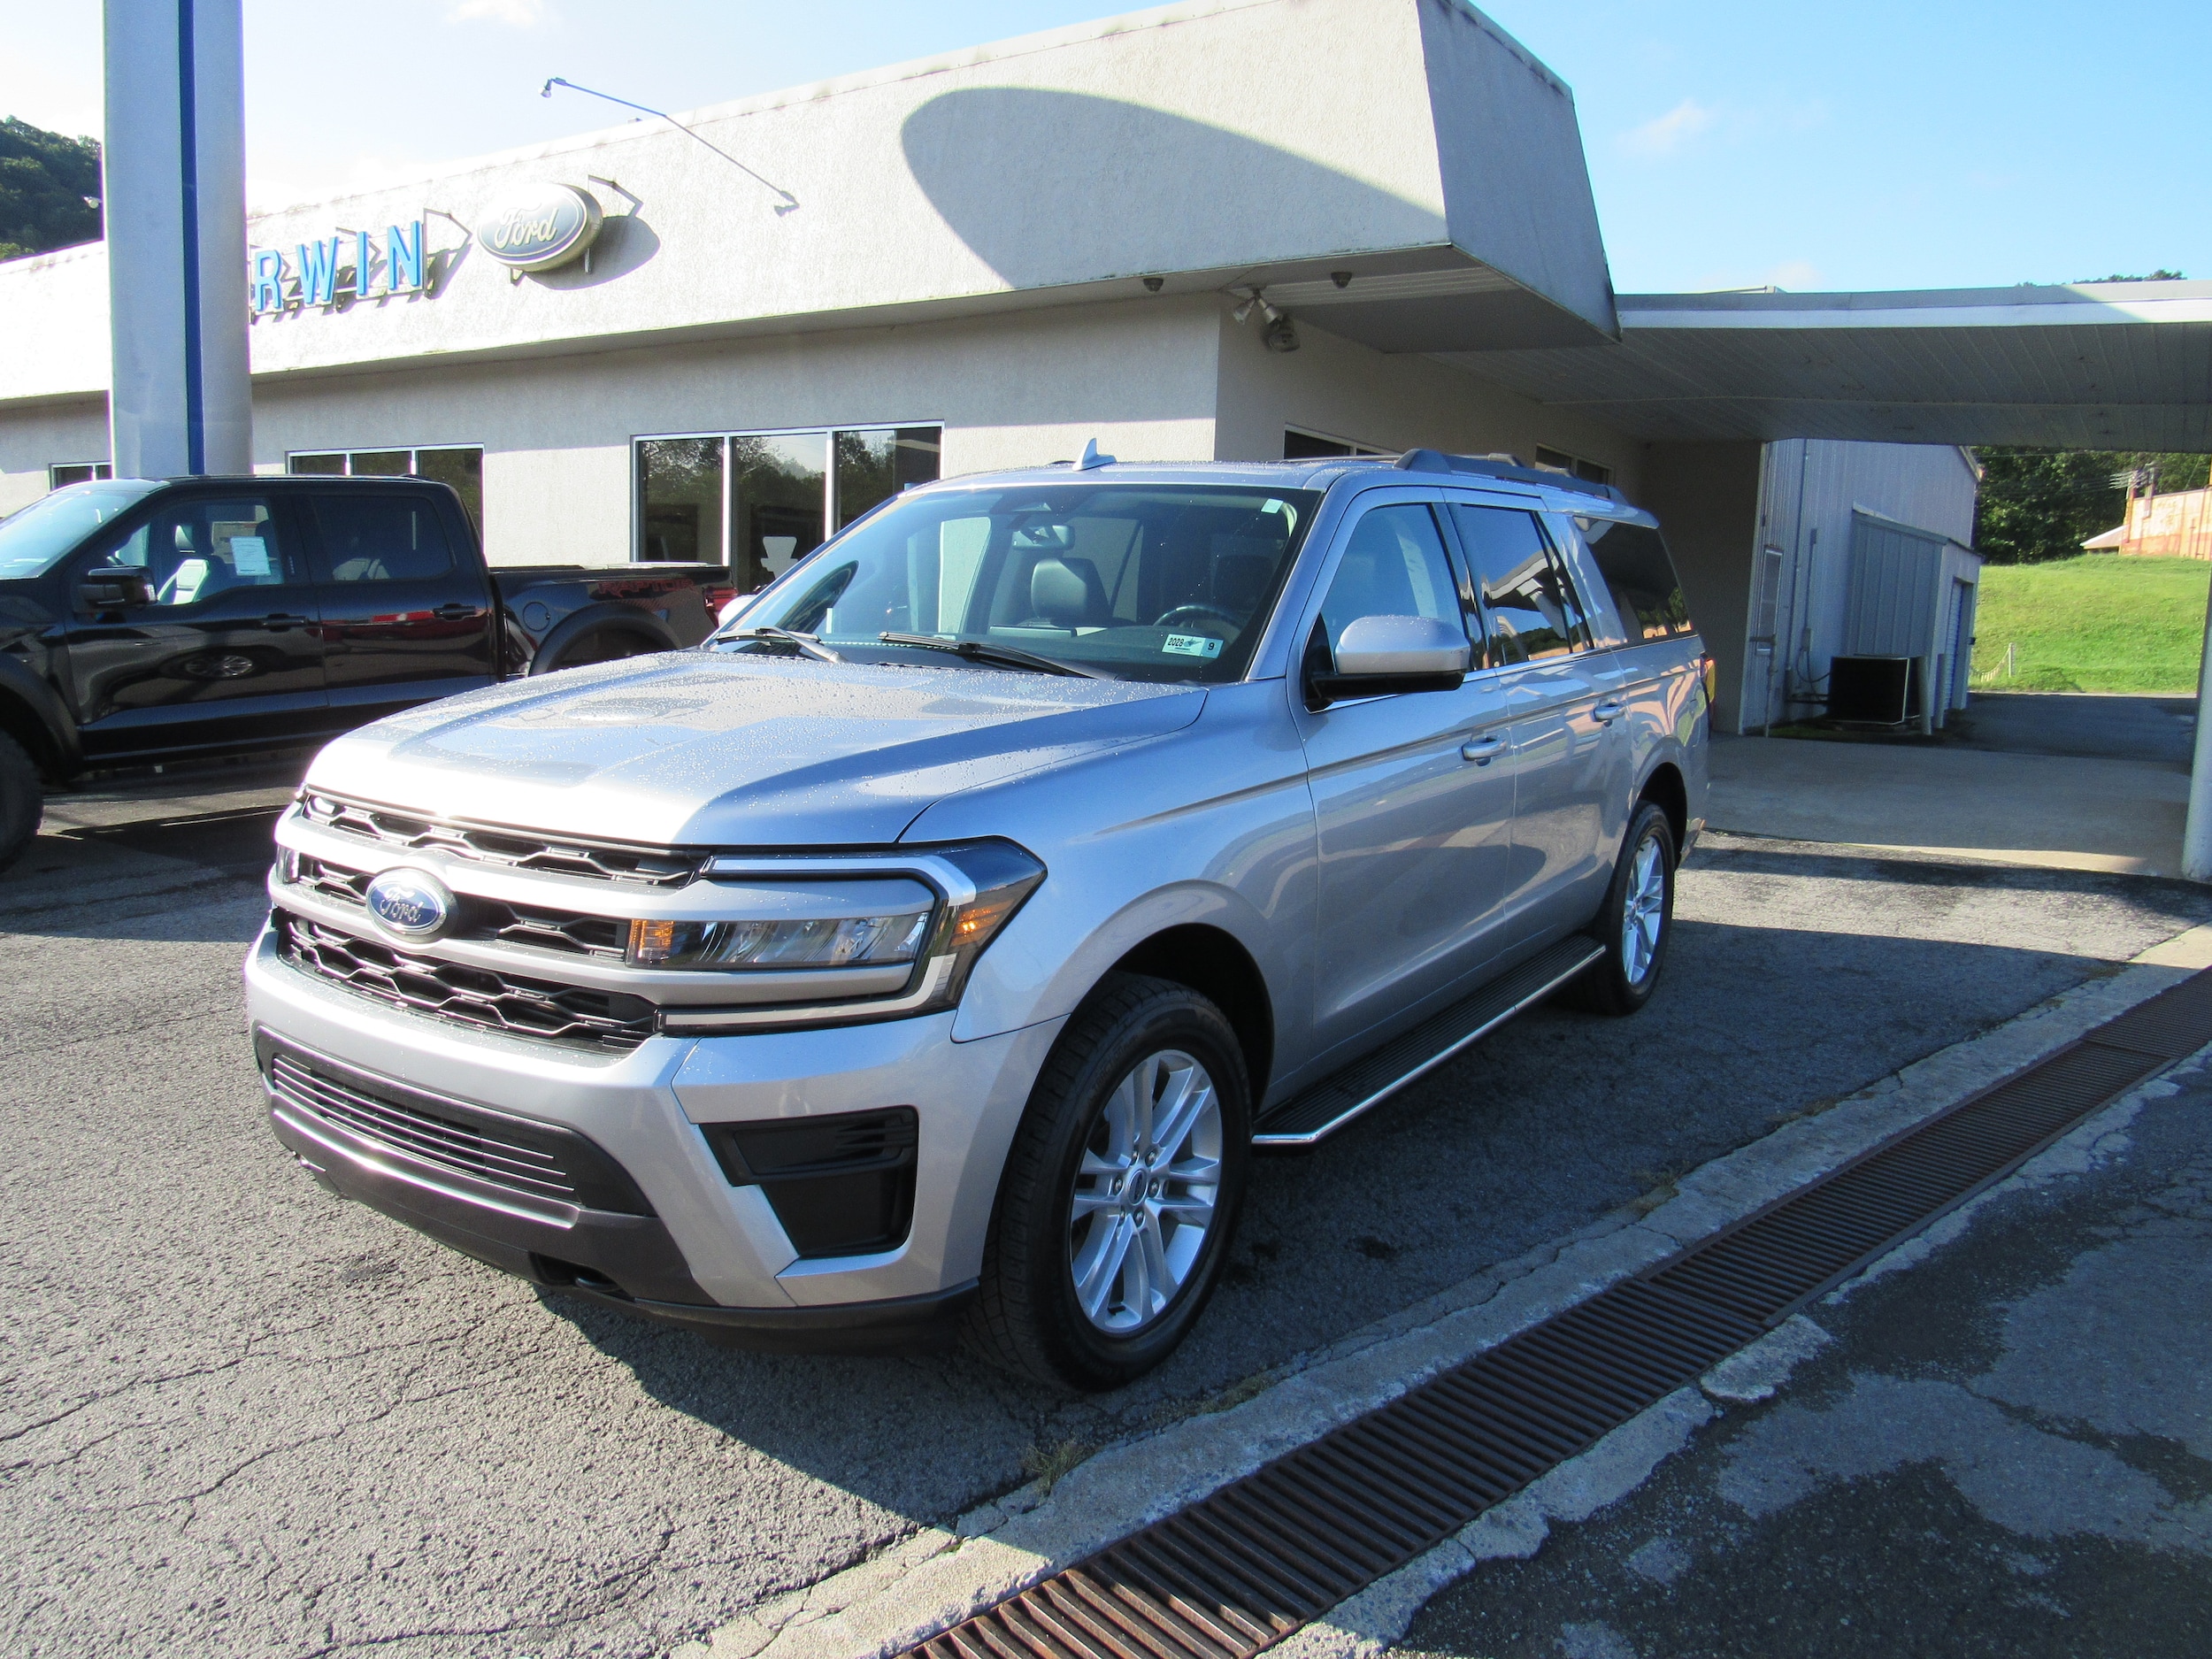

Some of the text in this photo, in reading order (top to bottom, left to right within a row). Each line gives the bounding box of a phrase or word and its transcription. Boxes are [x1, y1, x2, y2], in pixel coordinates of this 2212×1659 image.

[494, 202, 560, 250] Ford
[597, 579, 699, 598] RAPTOR
[1168, 637, 1184, 647] 2028
[380, 887, 424, 923] Ford
